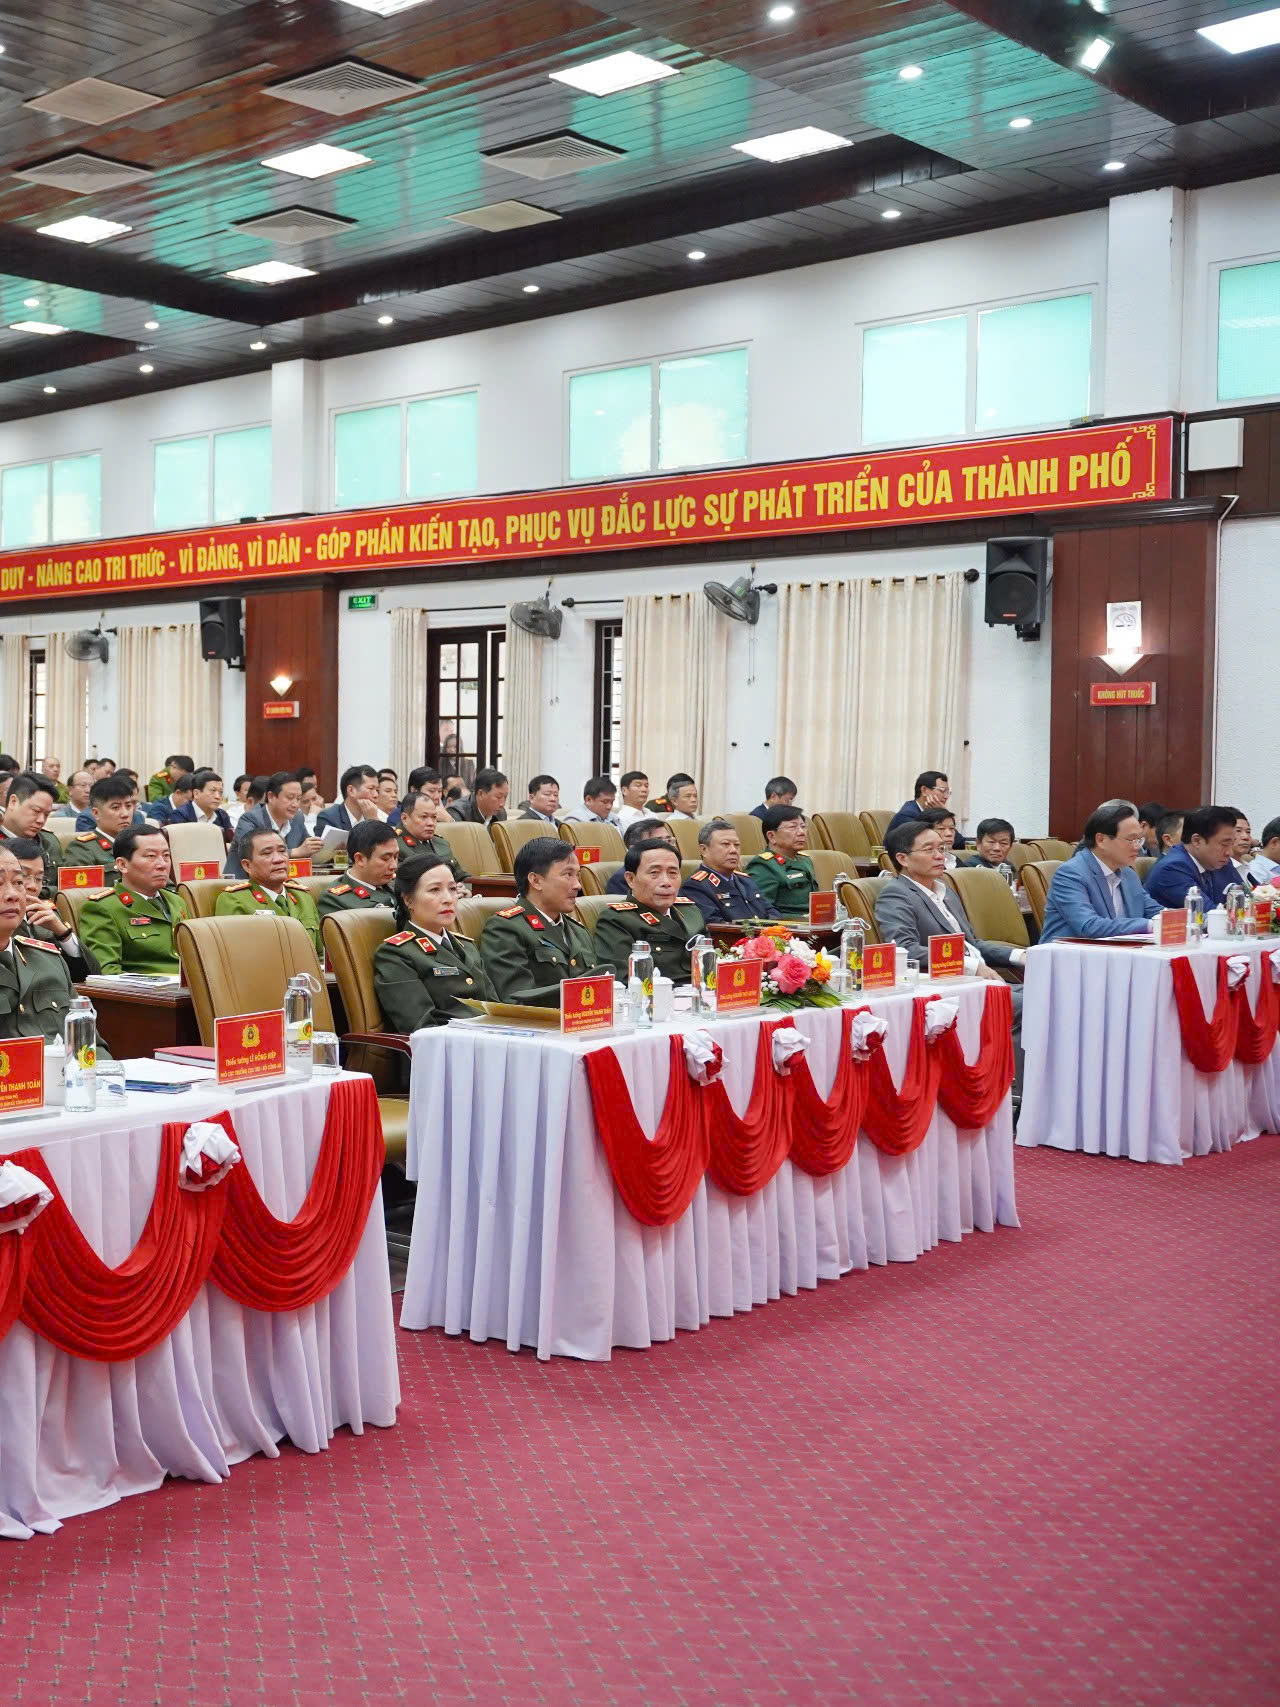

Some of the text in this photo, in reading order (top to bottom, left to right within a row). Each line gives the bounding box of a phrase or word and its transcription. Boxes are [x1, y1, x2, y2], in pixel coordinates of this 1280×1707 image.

[2, 566, 24, 591] DUY
[36, 558, 72, 587] NÂNG
[76, 558, 101, 582] CAO
[105, 556, 126, 580] TRI
[130, 547, 165, 578] THỨC
[179, 544, 193, 573] VÌ
[197, 537, 243, 571] ĐẢNG,
[248, 536, 262, 567] VÌ
[267, 533, 300, 564] DÂN
[316, 527, 350, 560] GÓP
[356, 518, 404, 556] PHẦN
[410, 513, 452, 552] KIẾN
[458, 518, 499, 552] TẠO,
[506, 510, 560, 548] PHỤC
[568, 507, 594, 544] VỤ
[601, 492, 646, 536] ĐẮC
[653, 495, 696, 536] LỰC
[704, 488, 739, 531] SỰ
[744, 480, 806, 522] PHÁT
[813, 464, 888, 516] TRIỂN
[898, 460, 953, 508] CỦA
[962, 455, 1058, 501] THÀNH
[1069, 435, 1132, 491] PHỐ
[1098, 689, 1115, 699] KHÔNG
[9, 1082, 25, 1090] THANH
